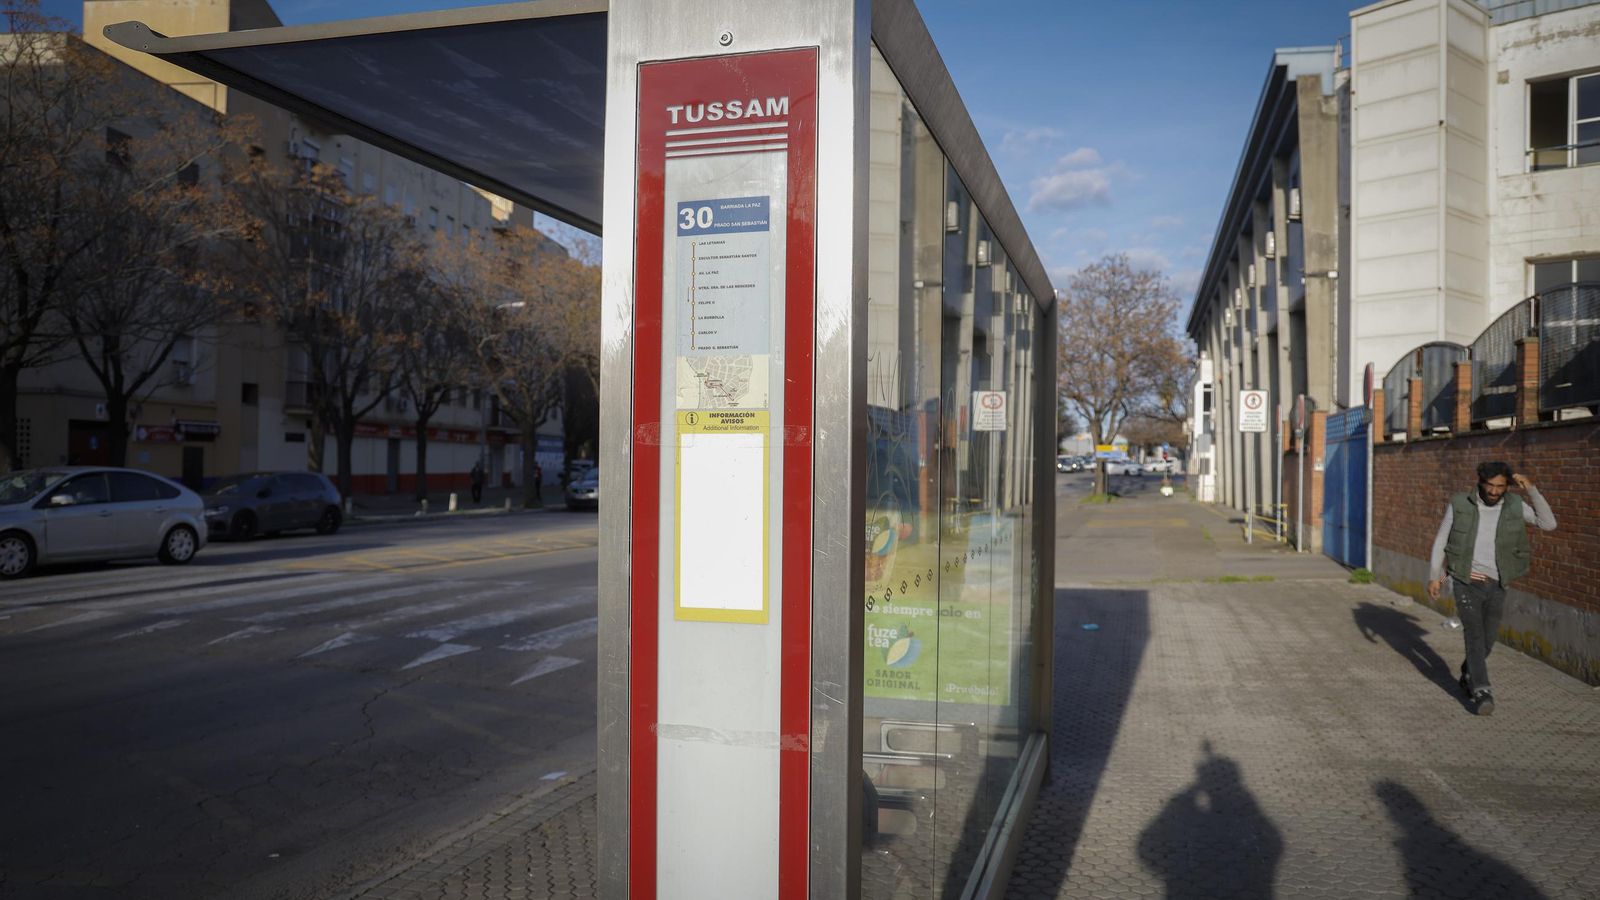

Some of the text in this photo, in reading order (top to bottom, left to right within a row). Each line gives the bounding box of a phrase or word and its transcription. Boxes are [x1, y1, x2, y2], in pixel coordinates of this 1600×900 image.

[666, 96, 789, 124] TUSSAM
[679, 206, 714, 230] 30
[882, 603, 934, 618] siempre
[964, 610, 982, 619] en
[867, 624, 898, 639] fuze
[868, 636, 890, 648] tea
[874, 670, 912, 680] SABOR
[866, 678, 921, 690] ORIGINAL
